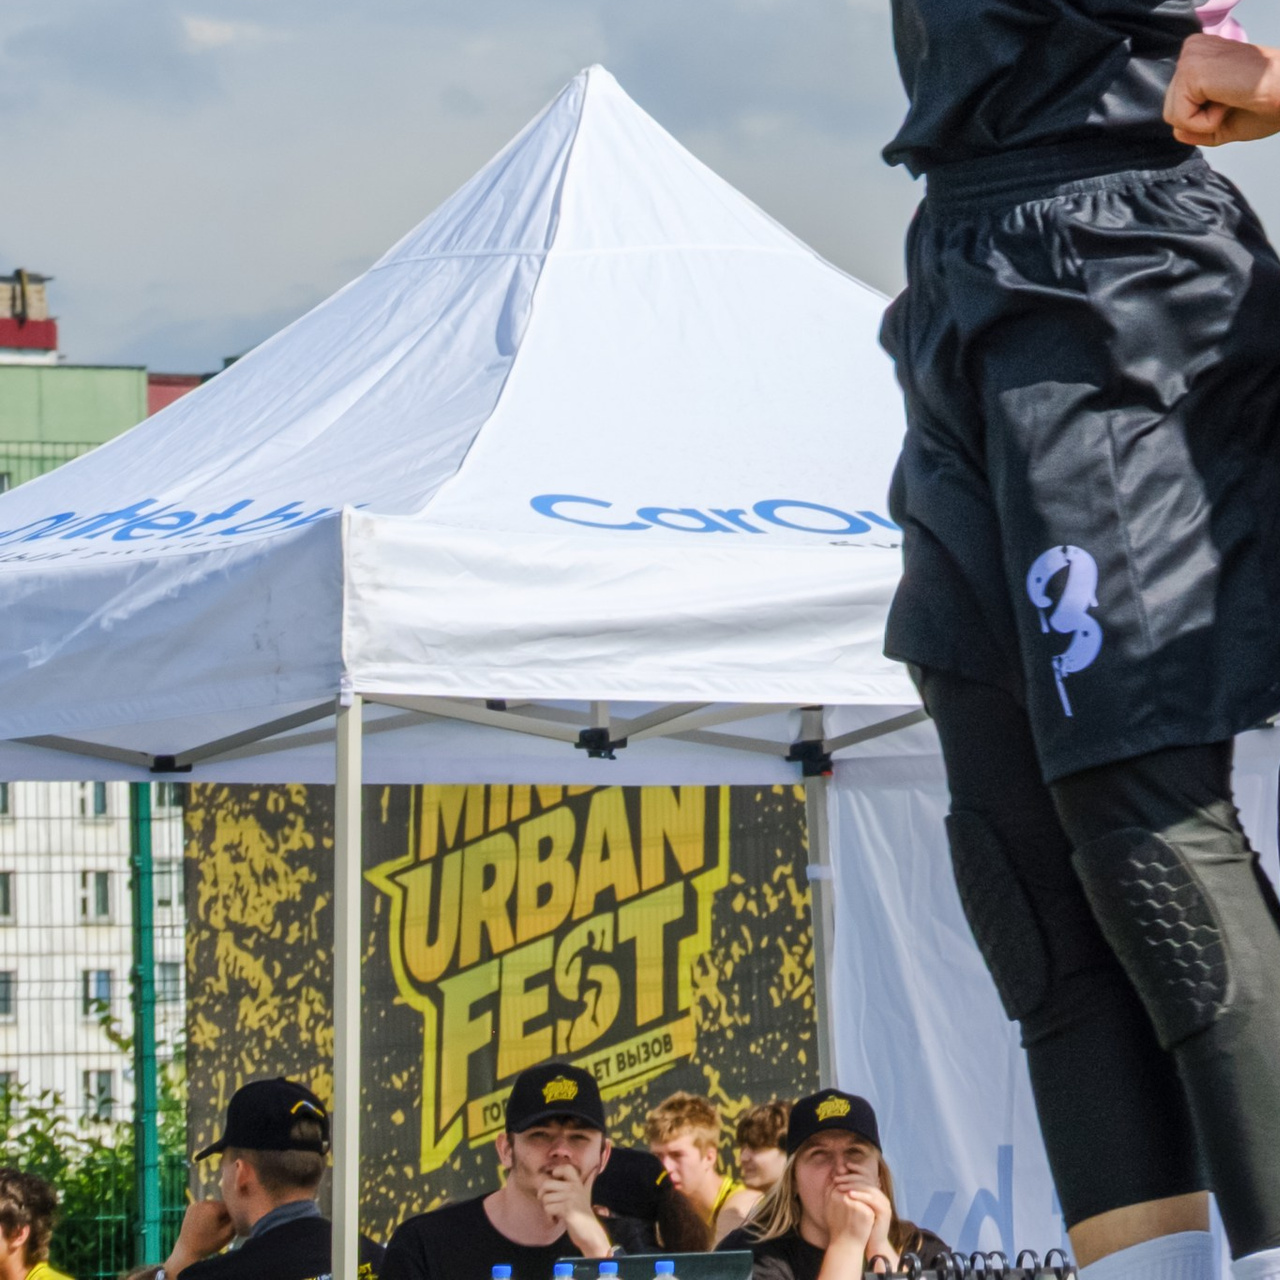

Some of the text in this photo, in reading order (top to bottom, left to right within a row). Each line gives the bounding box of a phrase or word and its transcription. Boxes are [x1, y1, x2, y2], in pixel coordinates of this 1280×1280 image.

[394, 784, 705, 983] URBAN
[437, 880, 685, 1132] FEST
[616, 1033, 673, 1073] ВЫЗОВ
